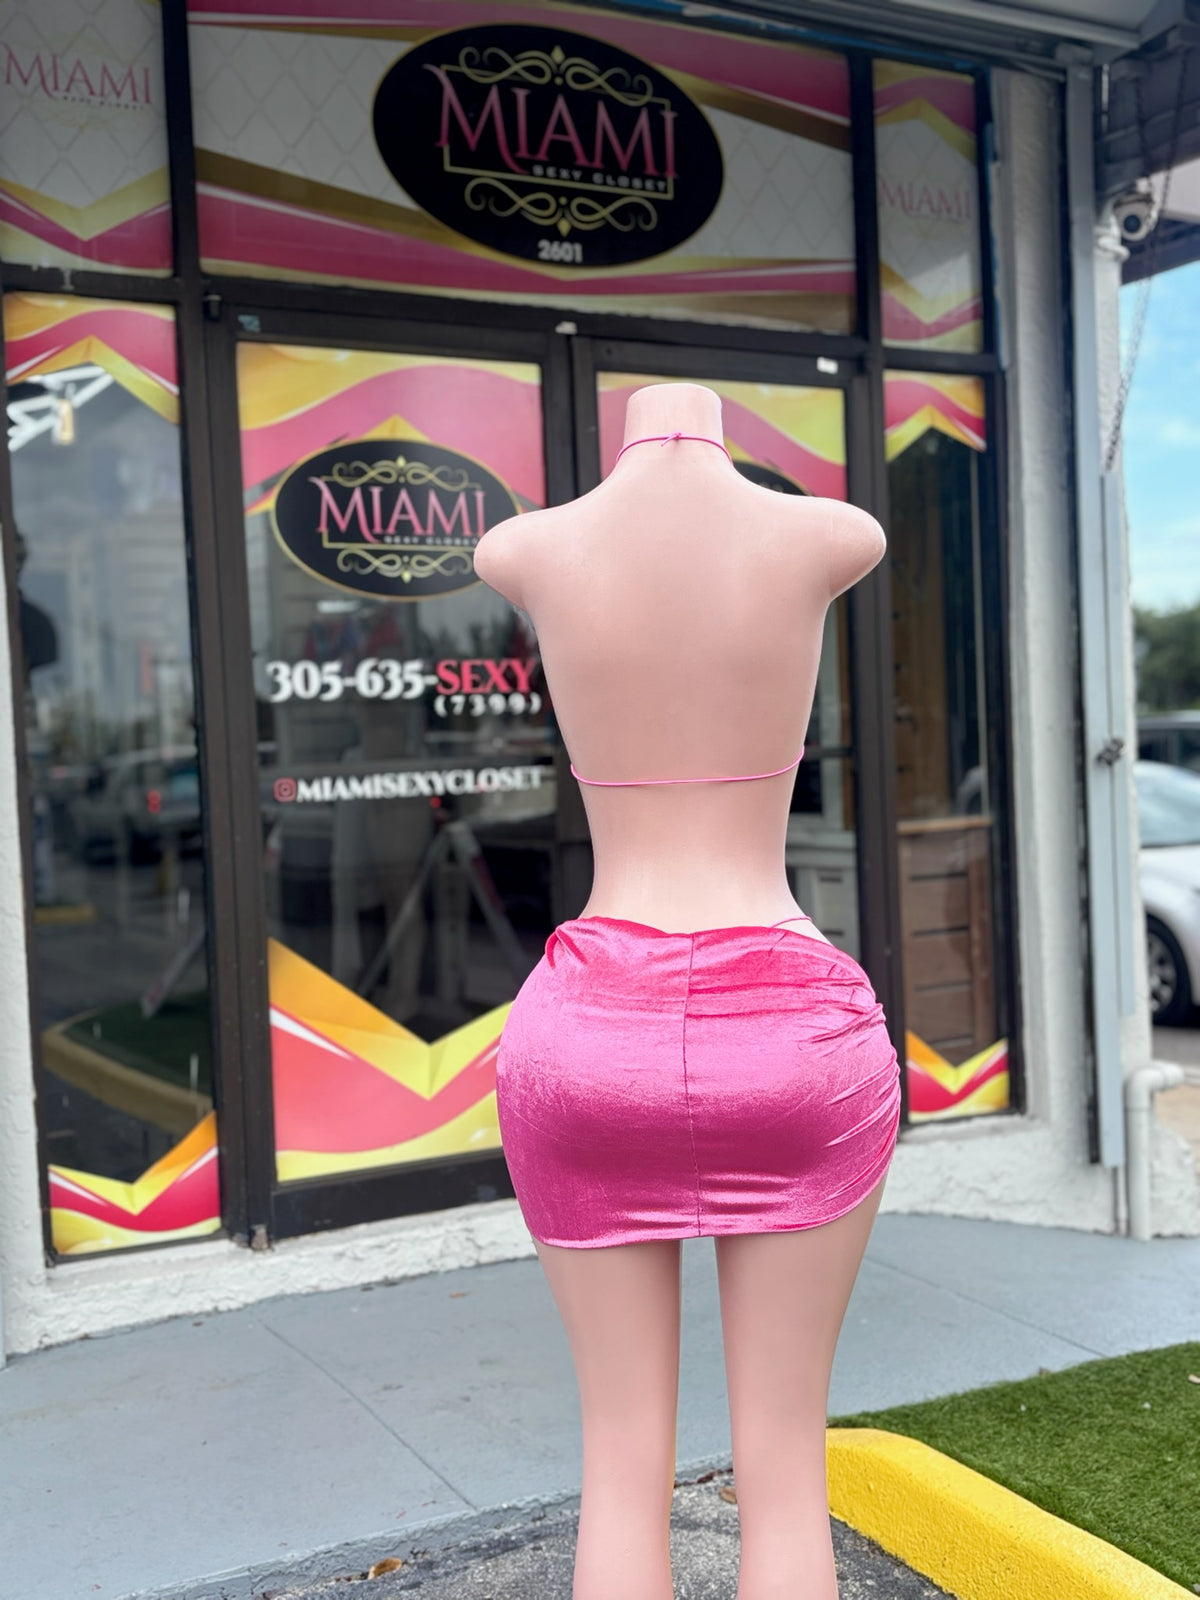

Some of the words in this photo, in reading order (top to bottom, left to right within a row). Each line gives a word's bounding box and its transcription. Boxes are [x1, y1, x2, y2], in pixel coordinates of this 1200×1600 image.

[1, 40, 151, 104] MIAMI
[422, 63, 678, 179] MIAMI
[532, 164, 582, 181] SEXY
[592, 172, 667, 192] CLOSET
[878, 175, 971, 219] MIAMI
[538, 239, 583, 263] 2601
[308, 476, 486, 544] MIAMI
[266, 658, 536, 701] 305-635-SEXY
[434, 691, 542, 717] (7399)
[296, 764, 544, 803] MIAMISEXYCLOSET
